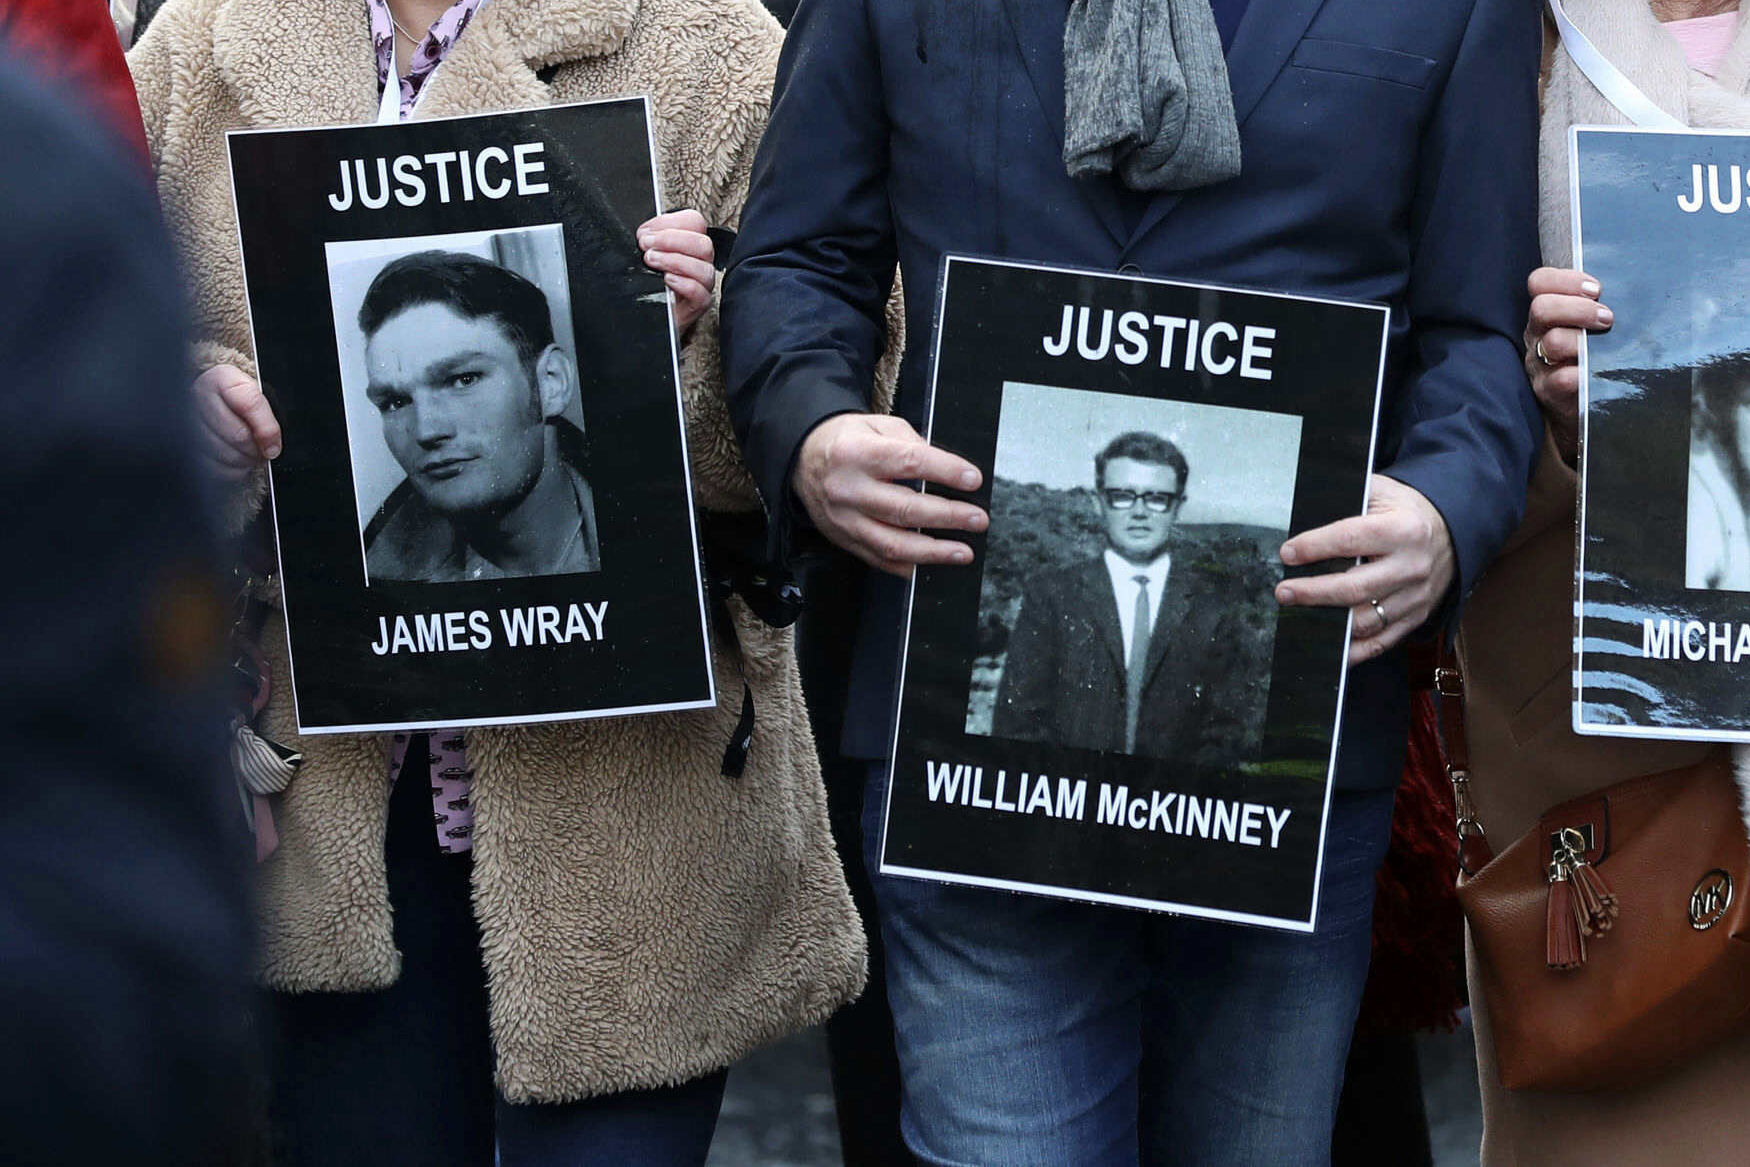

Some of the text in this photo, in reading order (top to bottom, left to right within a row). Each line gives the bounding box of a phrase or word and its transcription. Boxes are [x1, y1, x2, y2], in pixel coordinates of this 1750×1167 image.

[328, 142, 550, 211] JUSTICE
[1043, 305, 1276, 380] JUSTICE
[371, 601, 609, 655] JAMES WRAY
[927, 761, 1291, 848] WILLIAM McKINNEY
